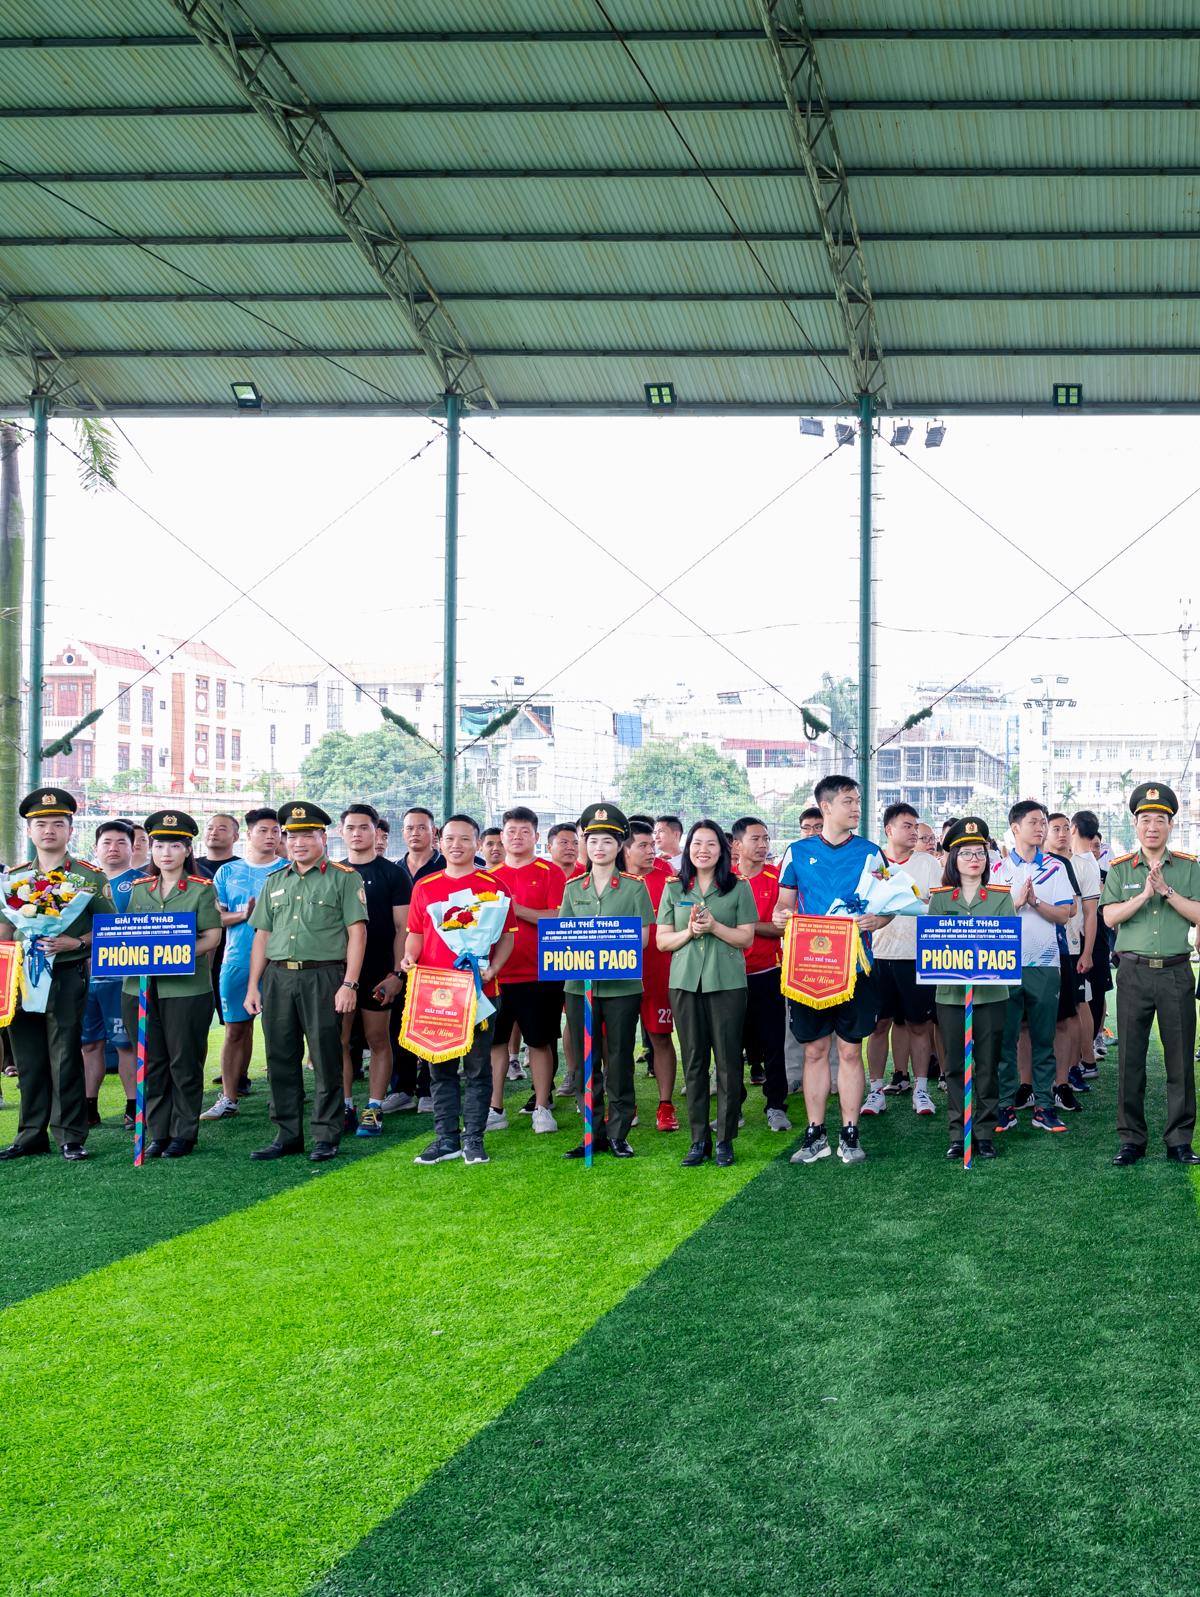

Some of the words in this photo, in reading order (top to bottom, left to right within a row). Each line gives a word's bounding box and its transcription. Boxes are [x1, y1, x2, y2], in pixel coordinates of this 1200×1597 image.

[132, 915, 148, 923] THỂ
[560, 920, 576, 928] GIẢI
[578, 919, 594, 927] THỂ
[939, 918, 955, 926] GIẢI
[957, 918, 974, 926] THỂ
[98, 942, 149, 966] PHÒNG
[154, 945, 191, 965] PA08
[544, 946, 594, 971] PHÒNG
[599, 950, 636, 969] PA06
[922, 945, 973, 969] PHÒNG
[978, 950, 1016, 970] PA05
[658, 1008, 672, 1023] 22
